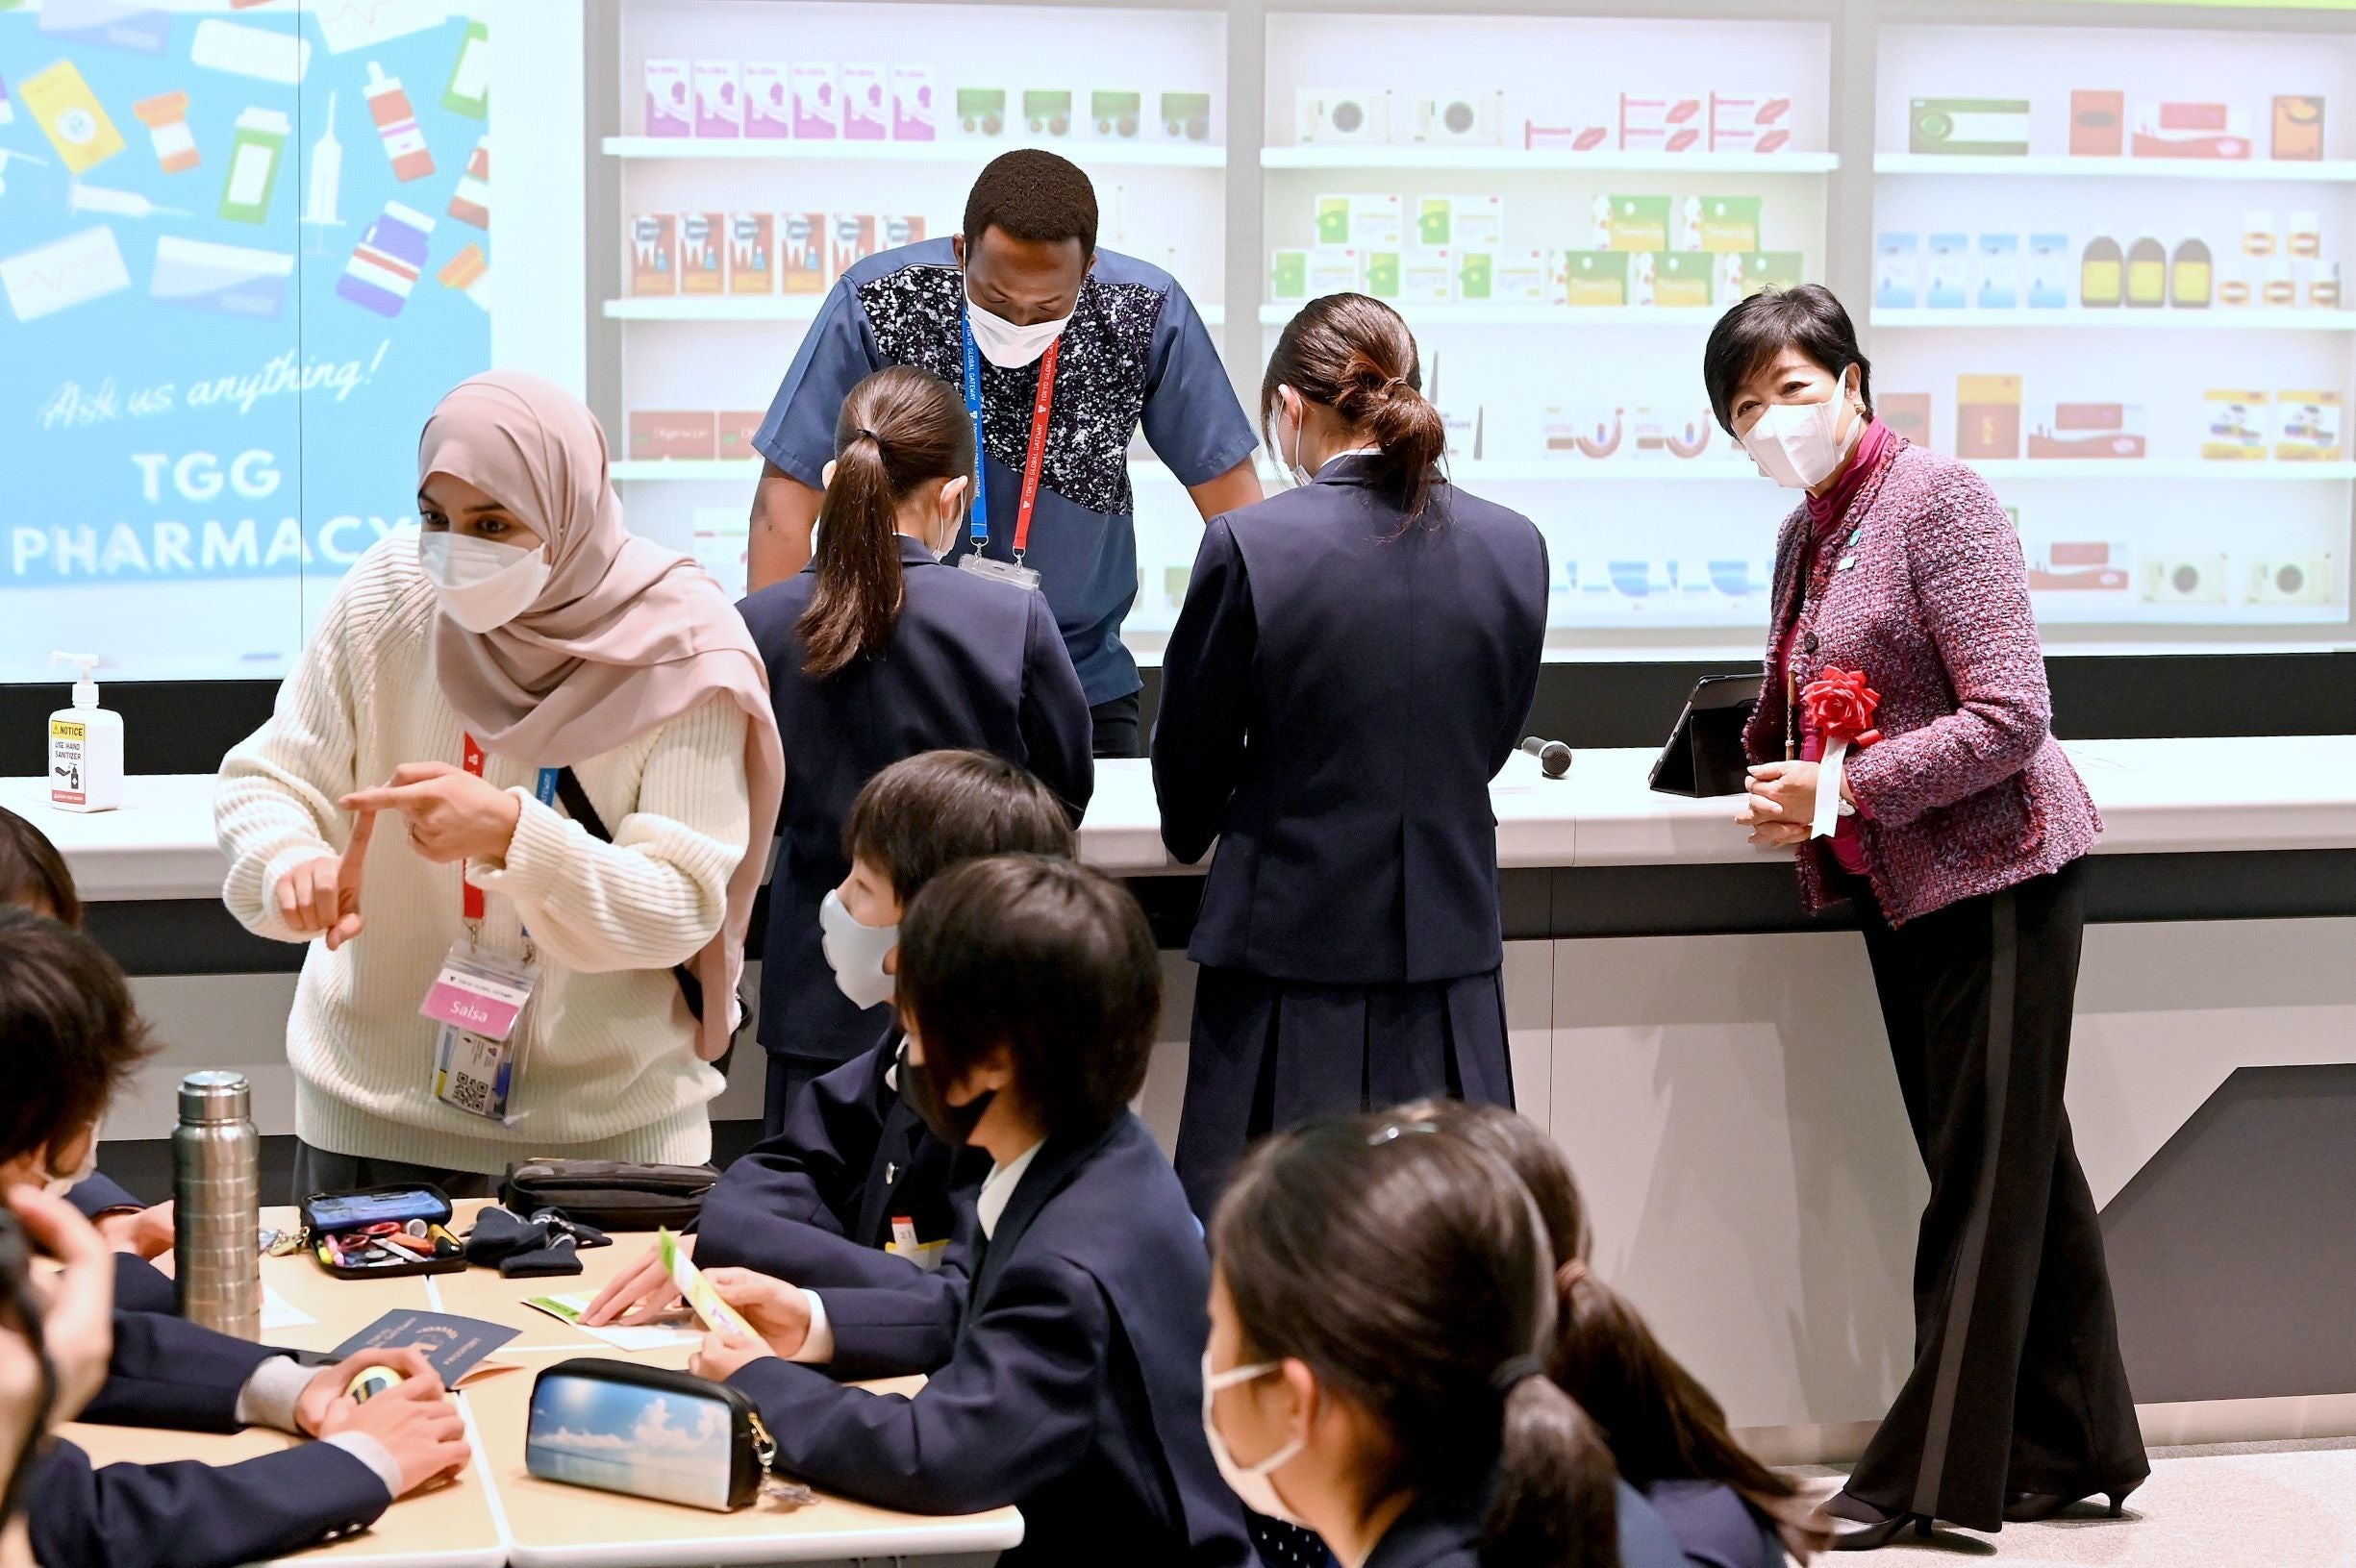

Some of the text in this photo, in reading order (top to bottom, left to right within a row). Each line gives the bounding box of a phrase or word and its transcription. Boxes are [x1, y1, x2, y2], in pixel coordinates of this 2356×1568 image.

[39, 338, 390, 429] Ask us anything!
[1040, 356, 1053, 402] TOKYO GLOBAL
[130, 449, 282, 504] TGG
[1026, 423, 1043, 497] TOKYO GLOBAL GATEWAY
[60, 726, 83, 736] NOTICE
[65, 742, 80, 751] HAND
[55, 751, 82, 760] SANITIZER
[449, 1001, 489, 1023] Salsa
